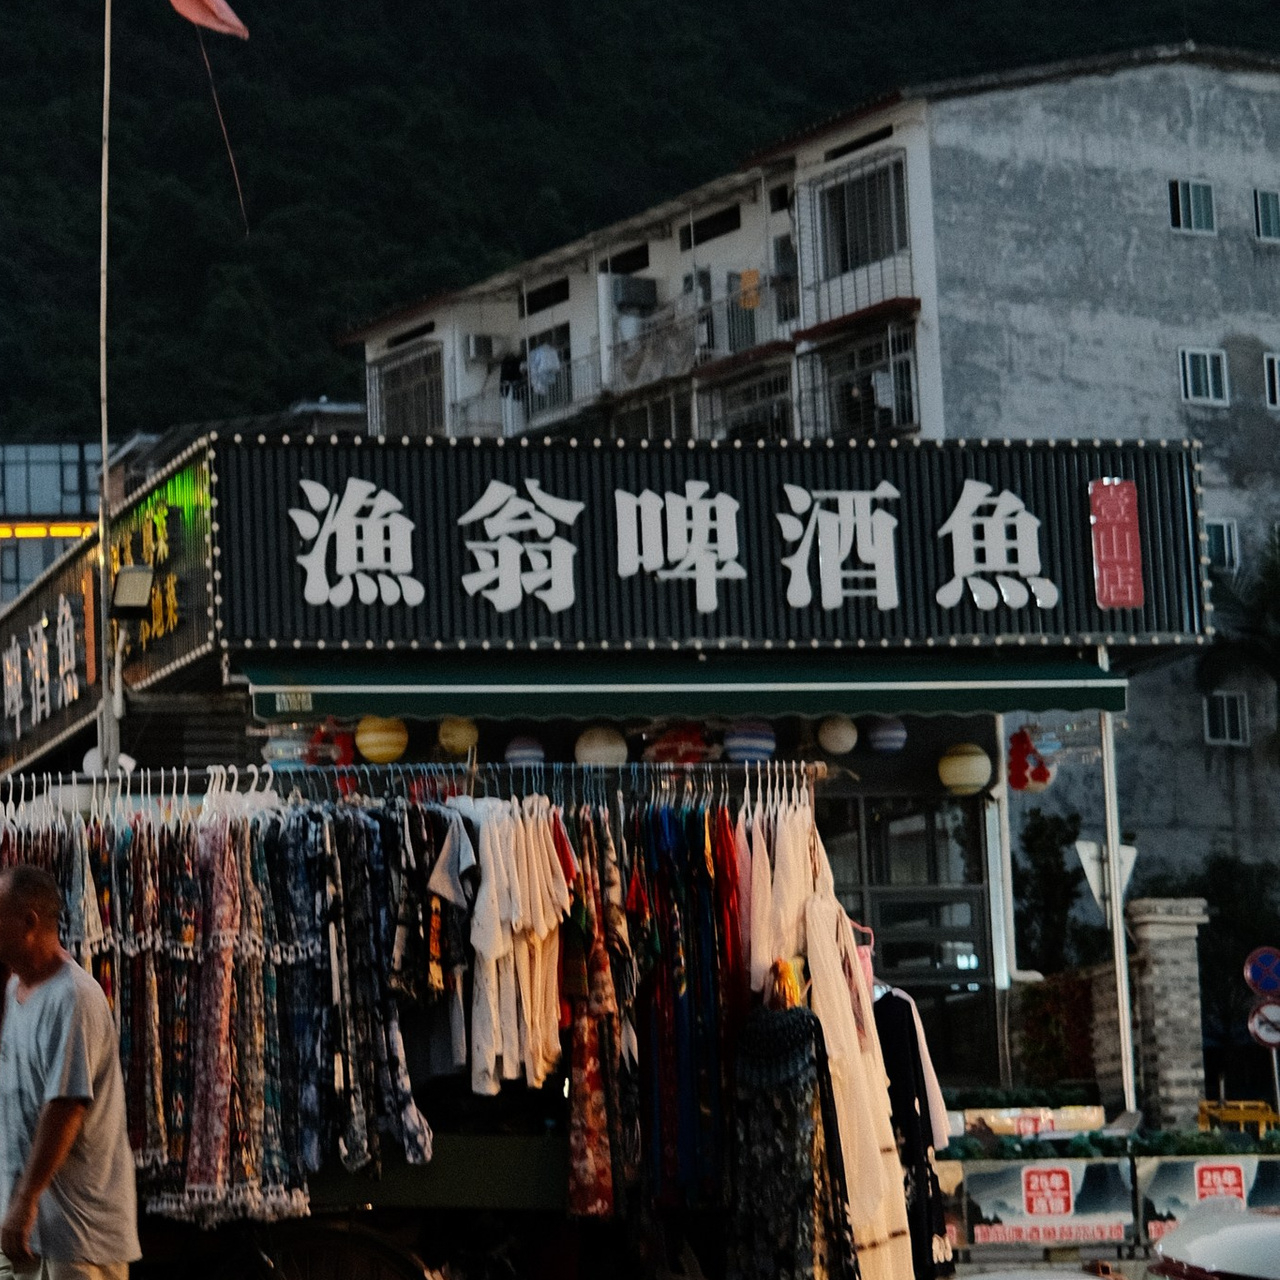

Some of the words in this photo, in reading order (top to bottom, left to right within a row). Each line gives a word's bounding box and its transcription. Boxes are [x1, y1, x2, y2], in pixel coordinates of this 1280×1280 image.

[288, 476, 1060, 614] 漁翁啤酒魚
